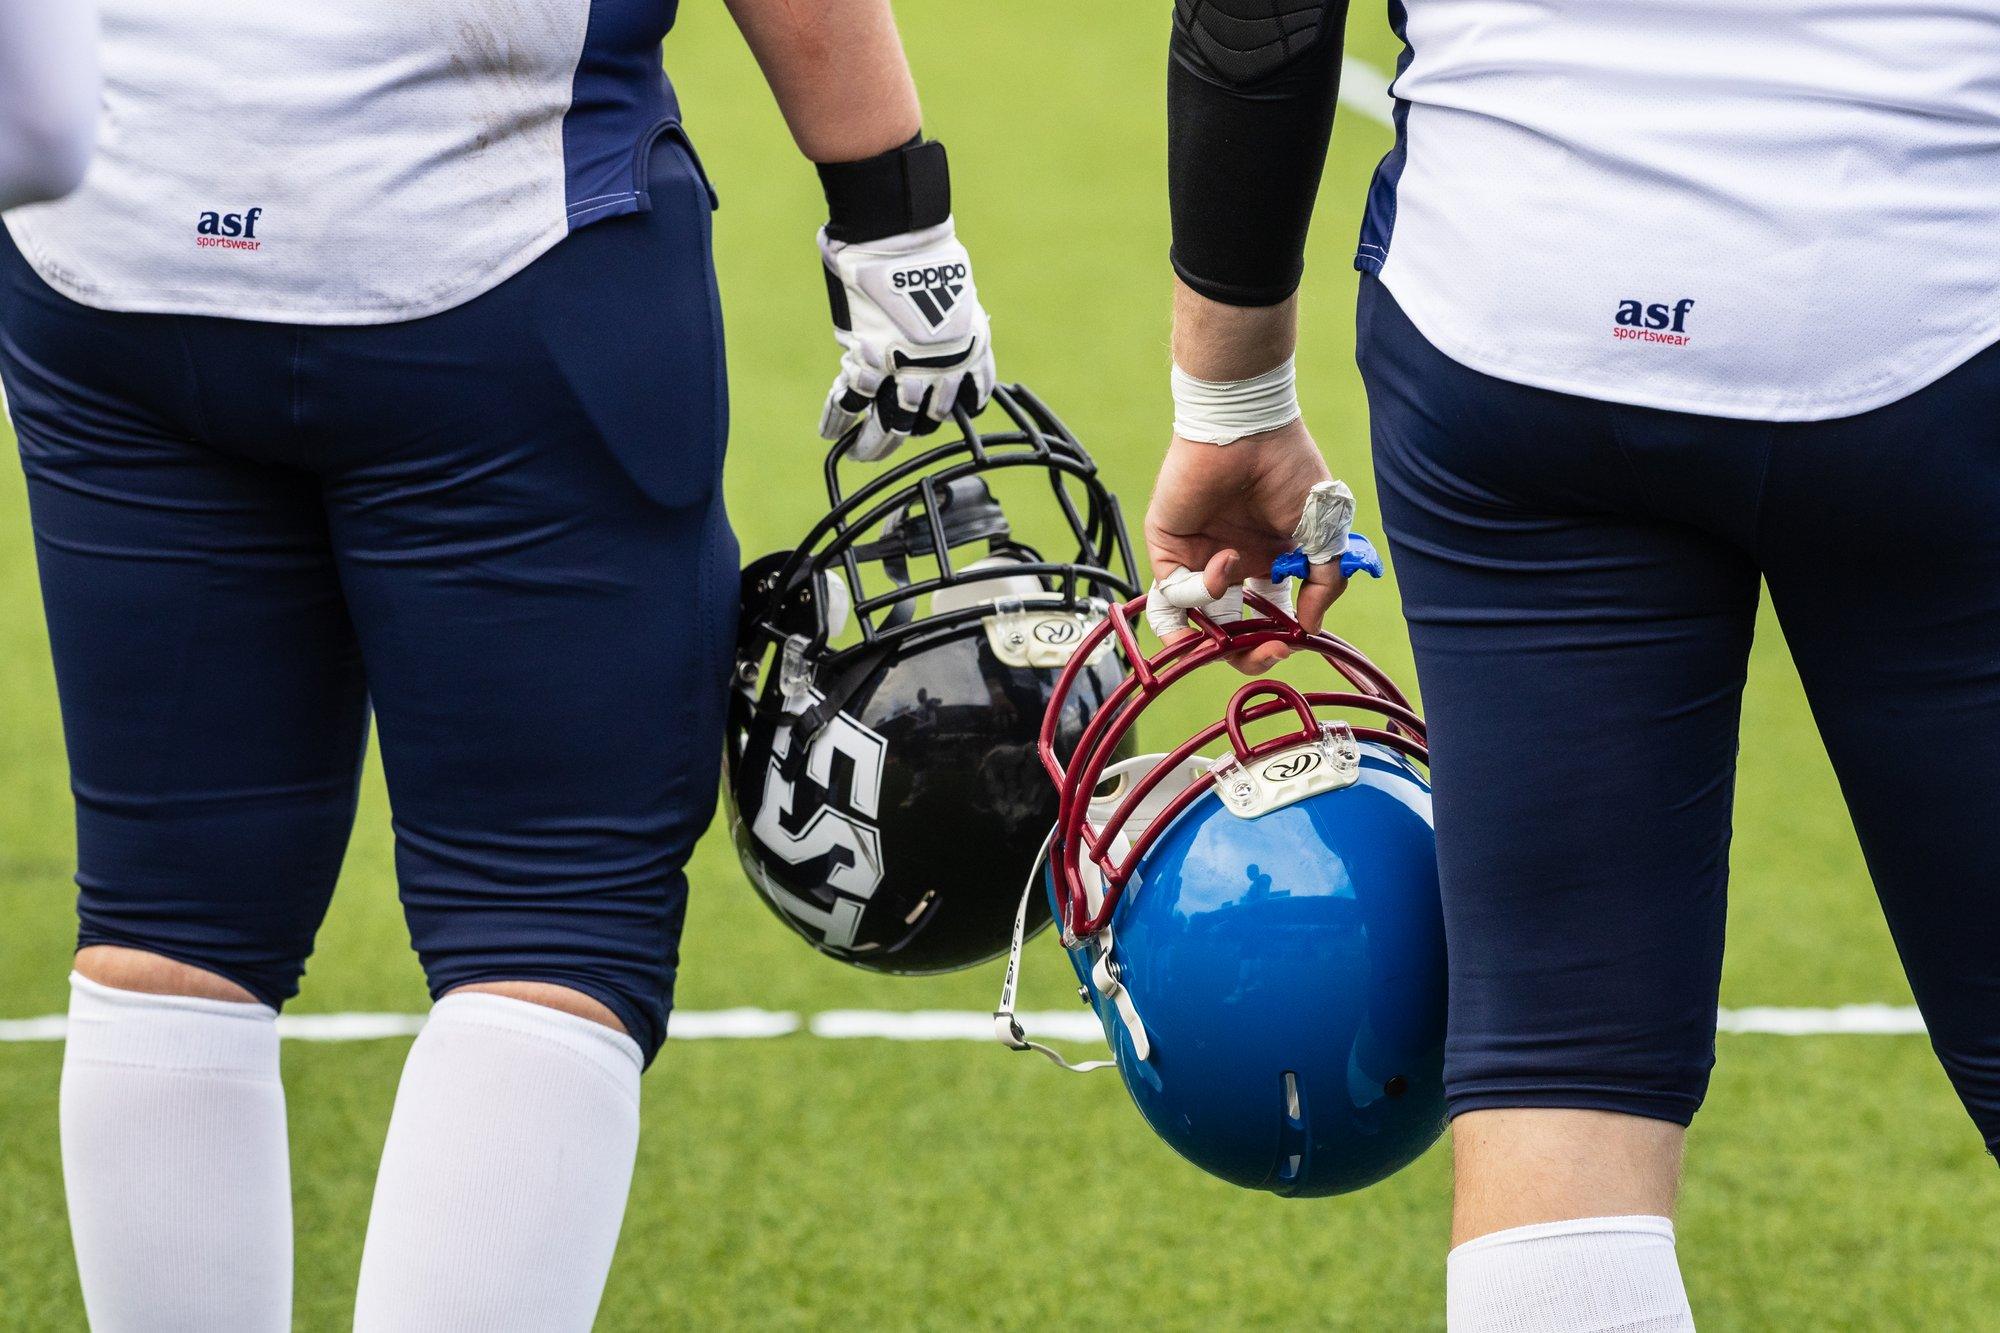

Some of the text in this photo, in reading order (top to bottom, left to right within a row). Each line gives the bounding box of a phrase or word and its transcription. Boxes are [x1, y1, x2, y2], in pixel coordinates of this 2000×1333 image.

[197, 207, 262, 238] asf
[196, 237, 261, 251] sportswear
[892, 263, 966, 289] adidas
[1615, 298, 1695, 333] asf
[1613, 327, 1691, 346] sportswear
